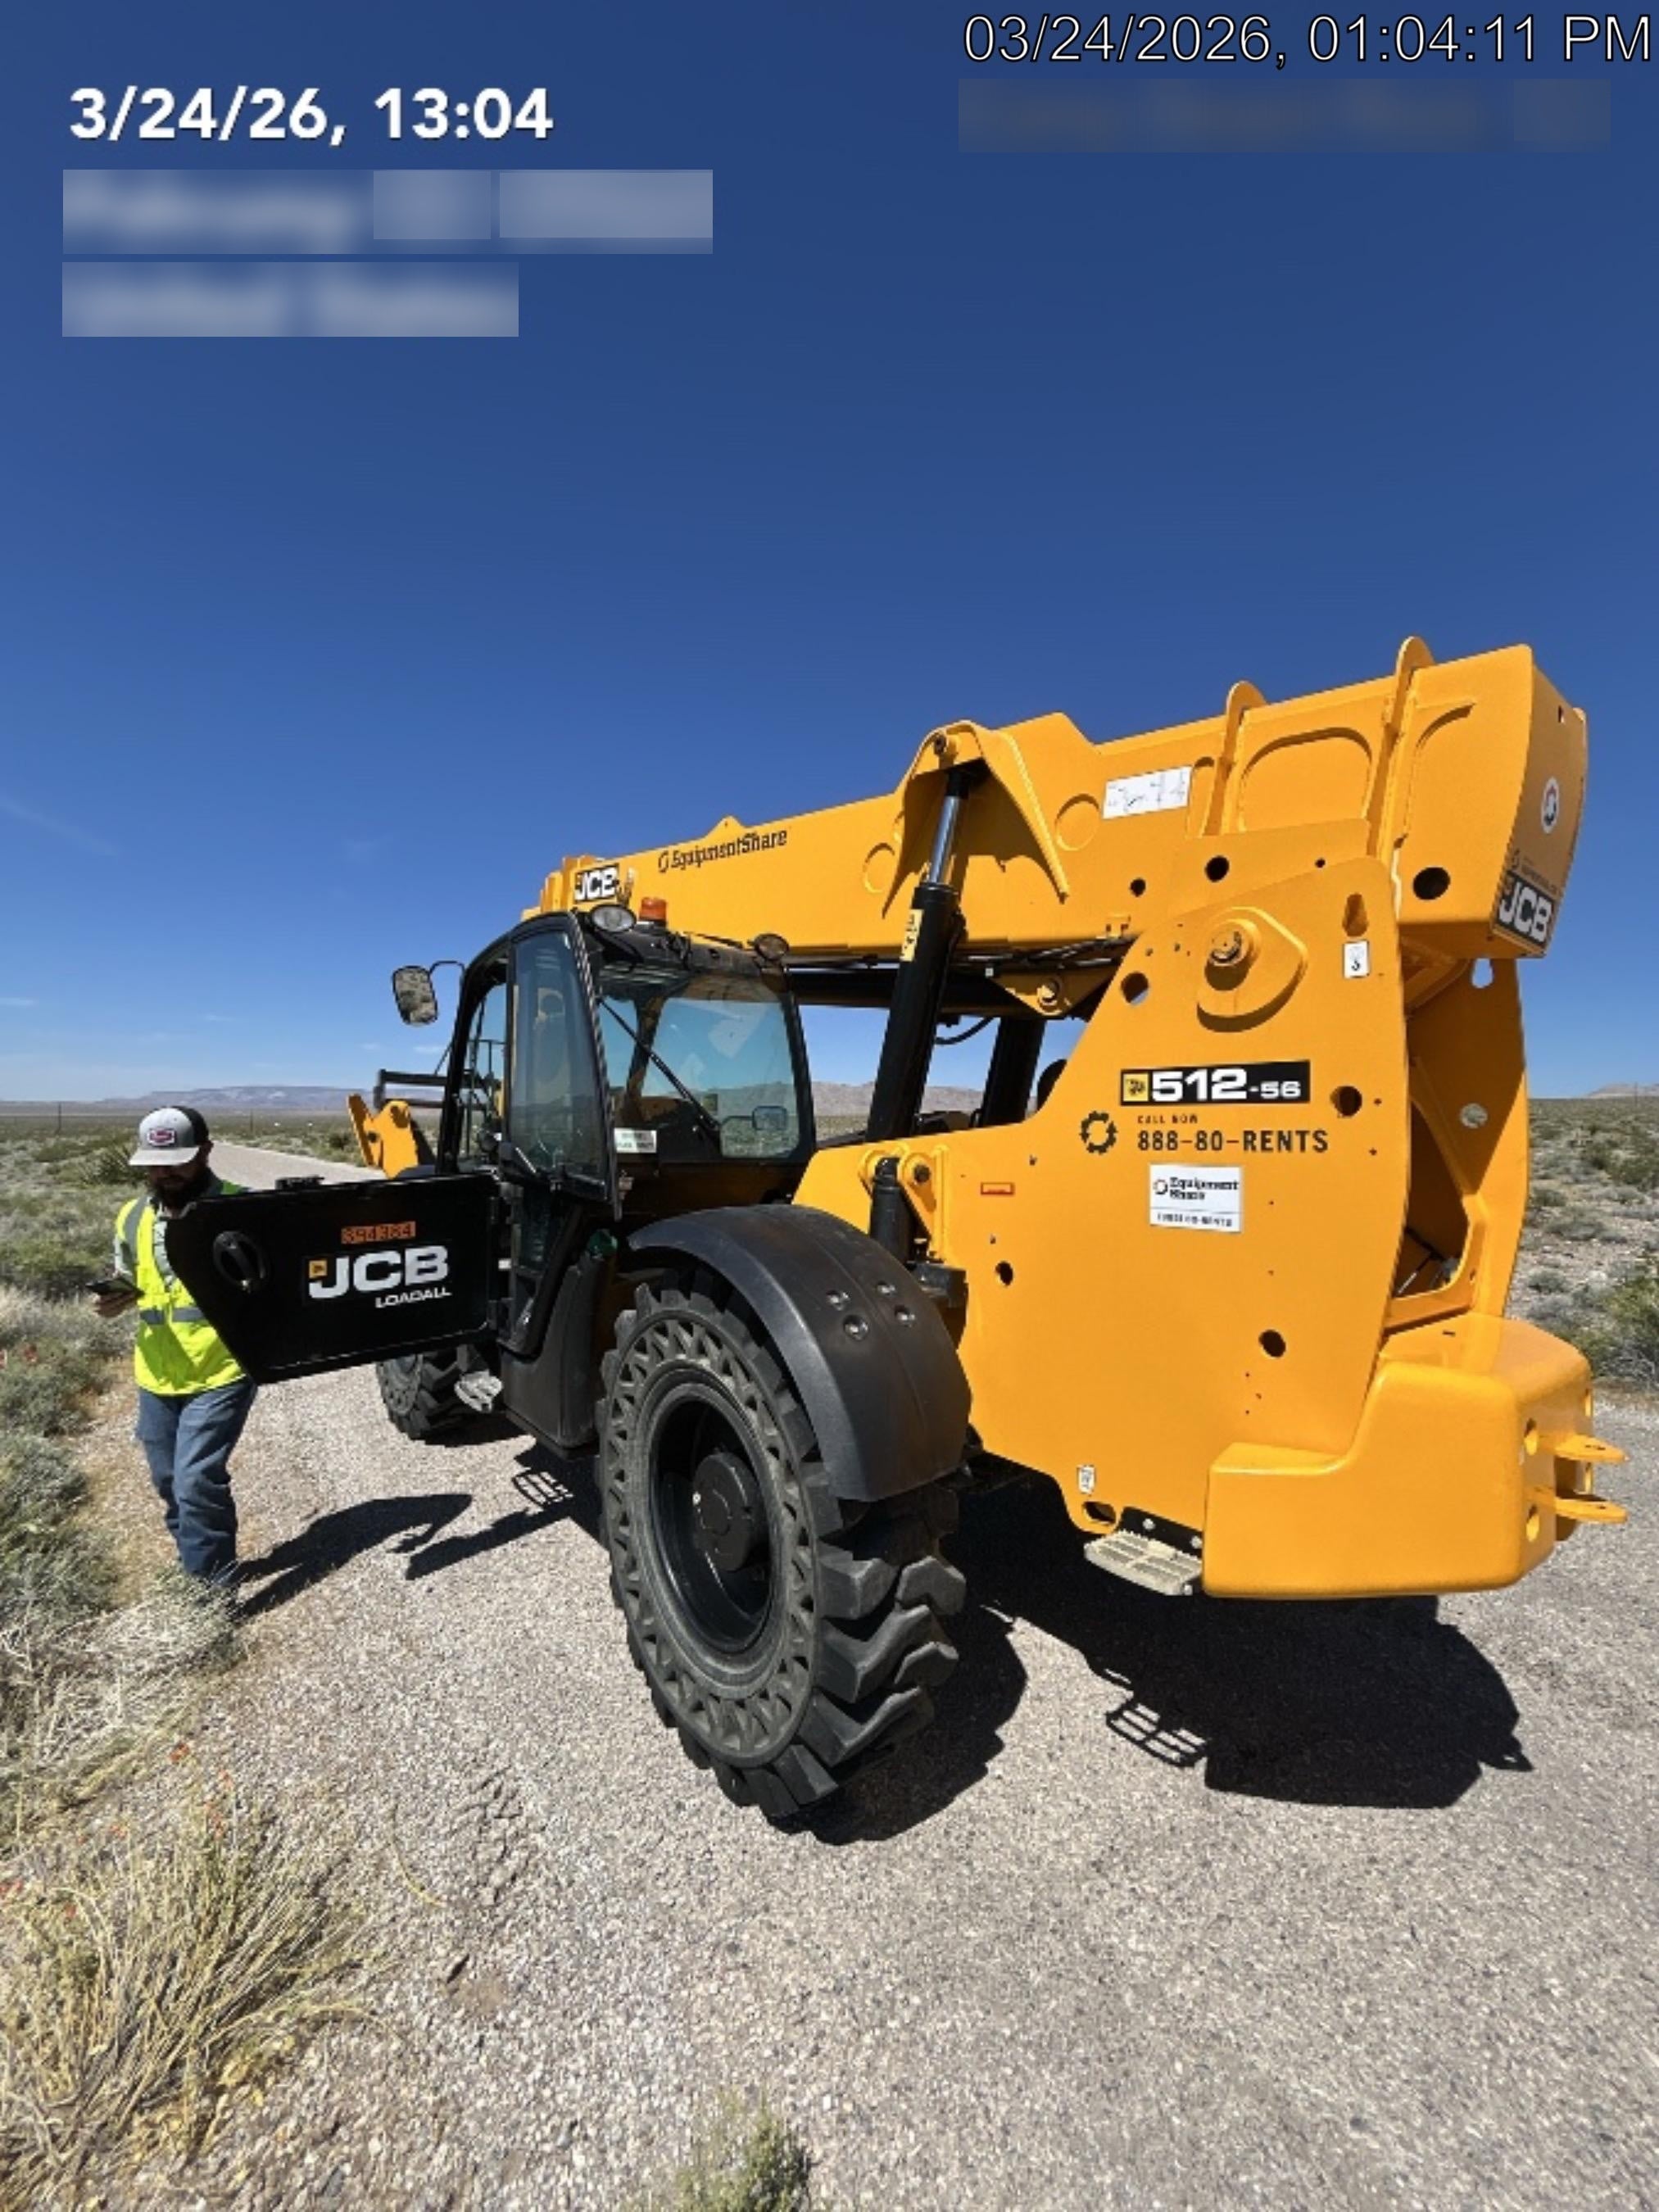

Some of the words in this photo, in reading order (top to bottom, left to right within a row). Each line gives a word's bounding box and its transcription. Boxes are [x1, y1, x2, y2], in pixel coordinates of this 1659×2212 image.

[670, 830, 787, 870] EquipmentShare
[573, 868, 617, 900] JCB
[1499, 882, 1552, 942] JCB
[1152, 1068, 1301, 1101] 512-56
[1137, 1115, 1166, 1124] CALL
[1137, 1130, 1329, 1153] 888-80-RENTS
[308, 1245, 448, 1299] JCB
[375, 1287, 452, 1308] LOADALL
